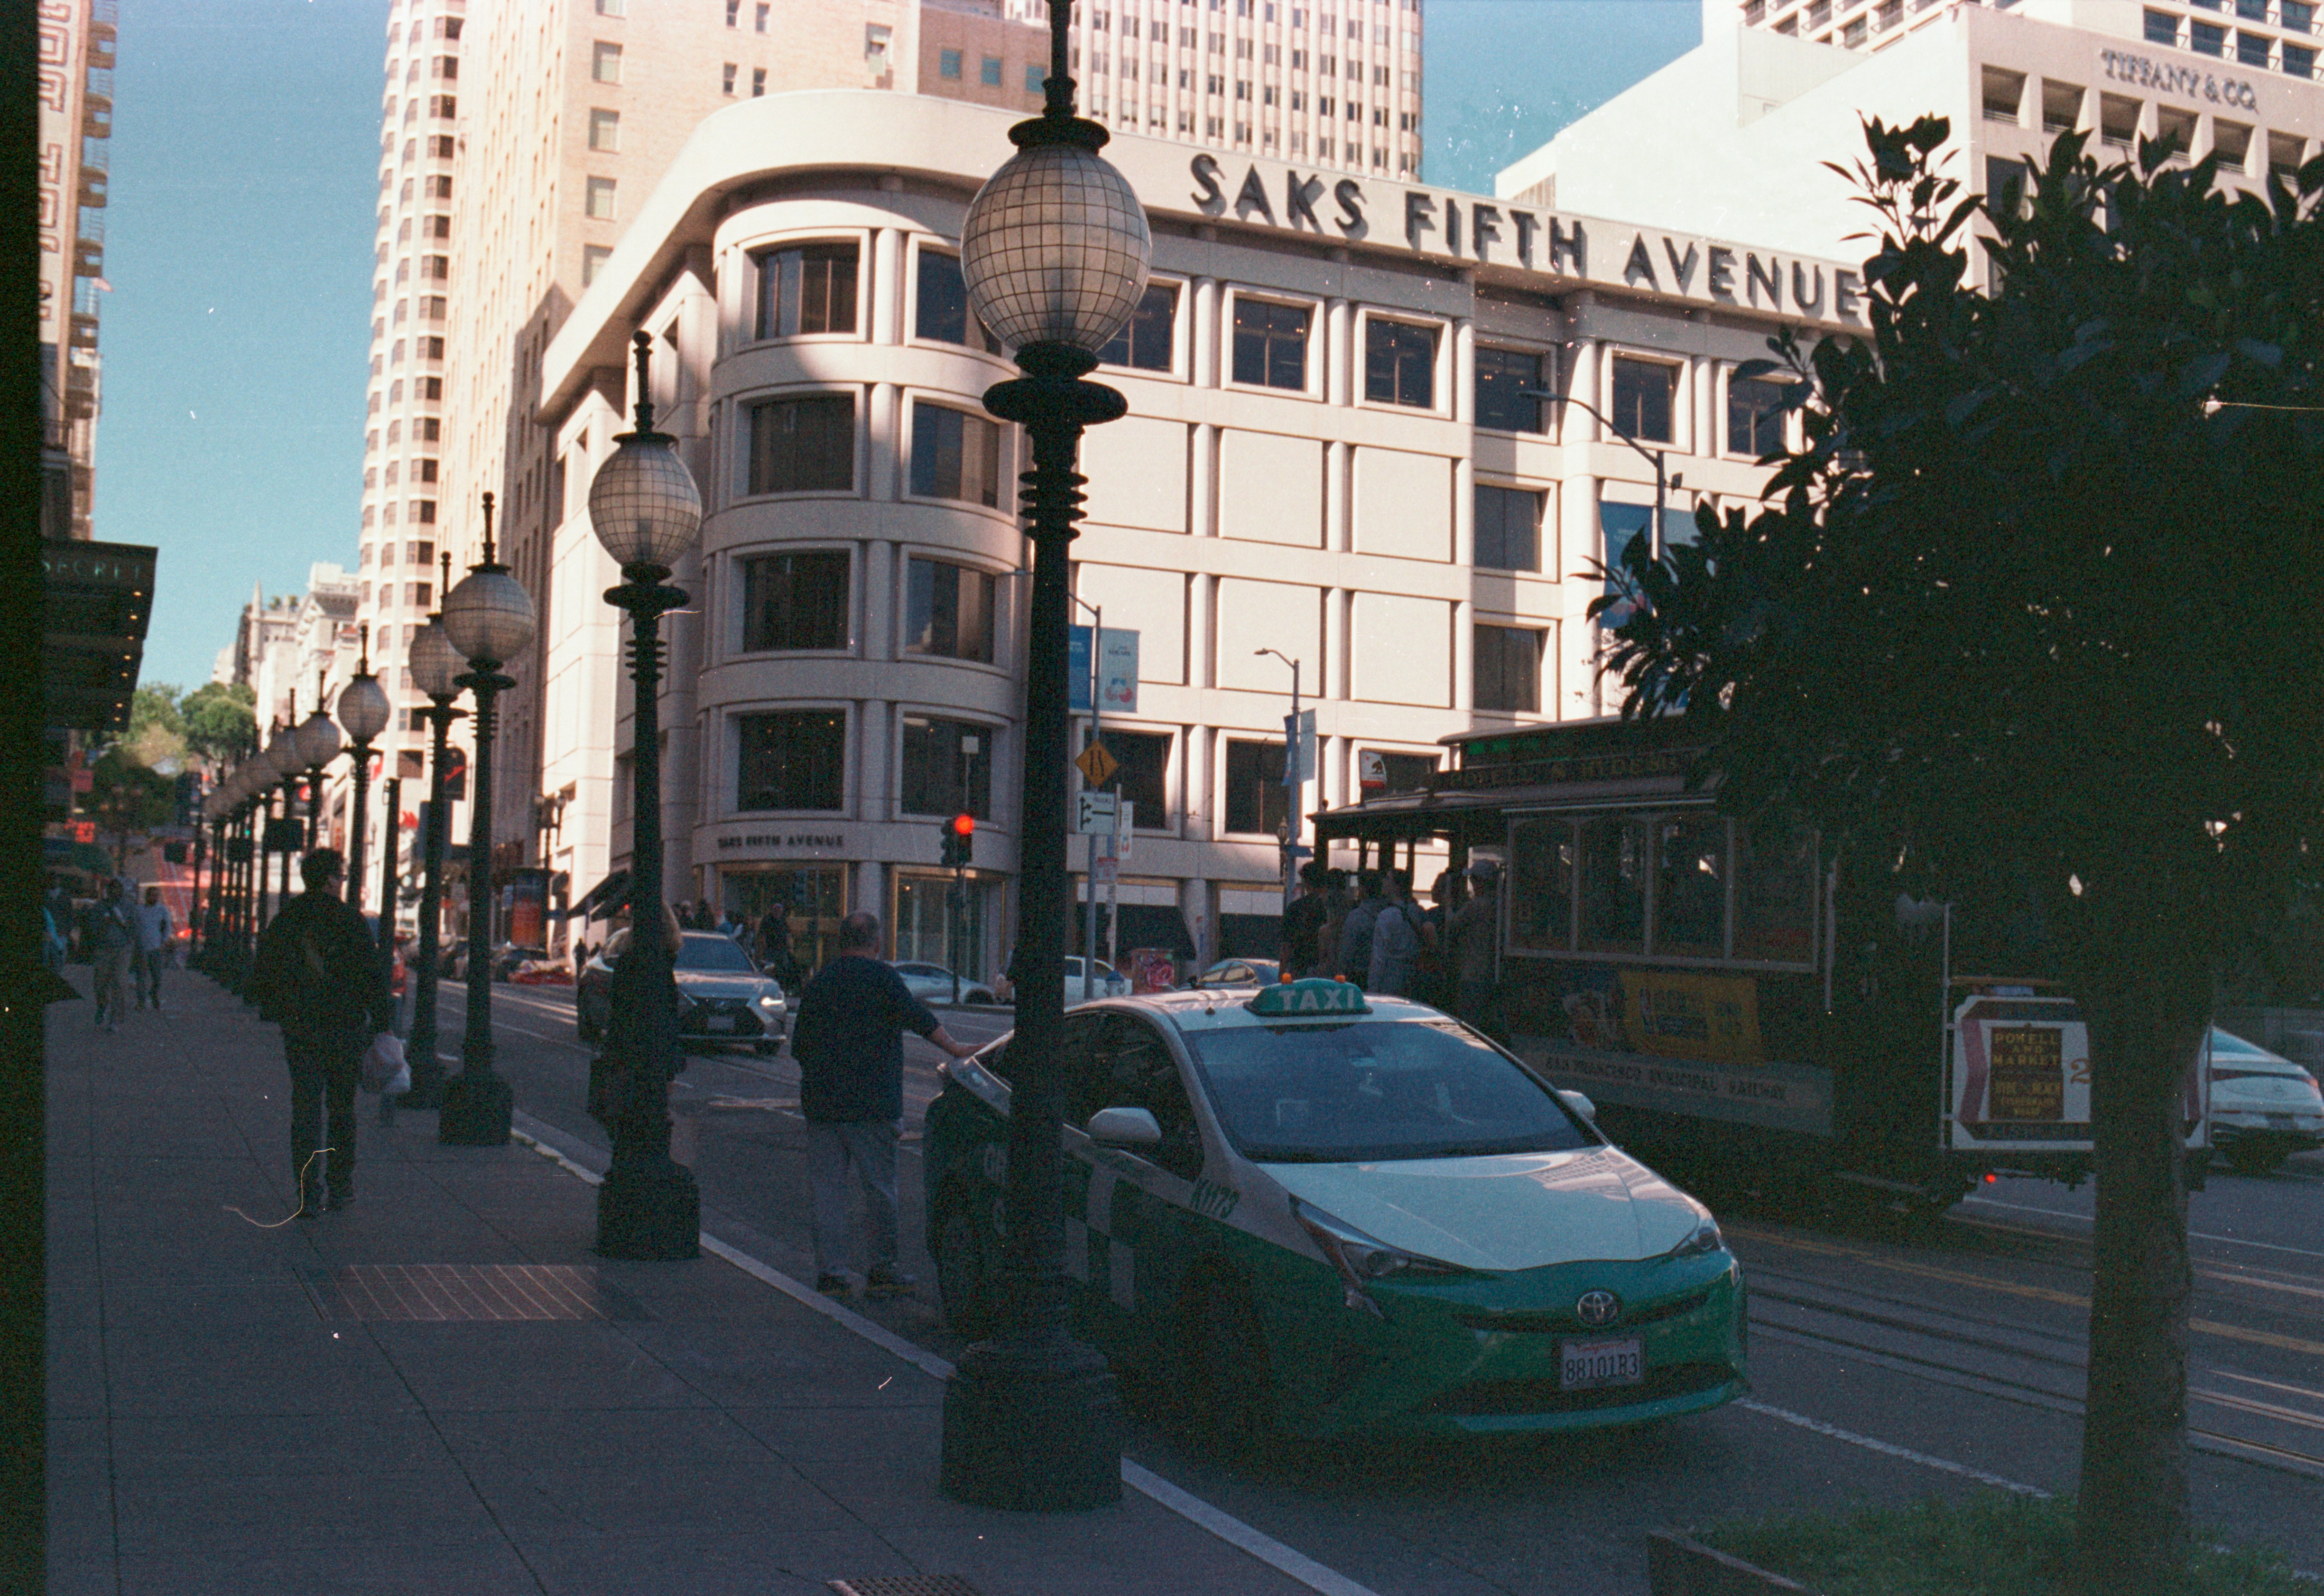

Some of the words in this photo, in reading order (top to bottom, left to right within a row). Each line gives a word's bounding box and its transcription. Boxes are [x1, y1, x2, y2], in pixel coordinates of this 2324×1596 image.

[2102, 48, 2200, 98] TIFFANY
[2204, 73, 2222, 103] &
[1190, 153, 1361, 232] SAKS
[1405, 190, 1583, 271] FIFTH
[1622, 231, 1859, 317] AVENUE
[717, 836, 742, 849] SAKS
[745, 835, 780, 846] FIFTH
[787, 835, 843, 847] AVENUE
[1278, 988, 1354, 1011] TAXI
[1994, 1033, 2056, 1045] POWELL
[2011, 1045, 2043, 1054] AND
[1992, 1054, 2058, 1066] MARKET
[1565, 1353, 1638, 1382] 88101B3
